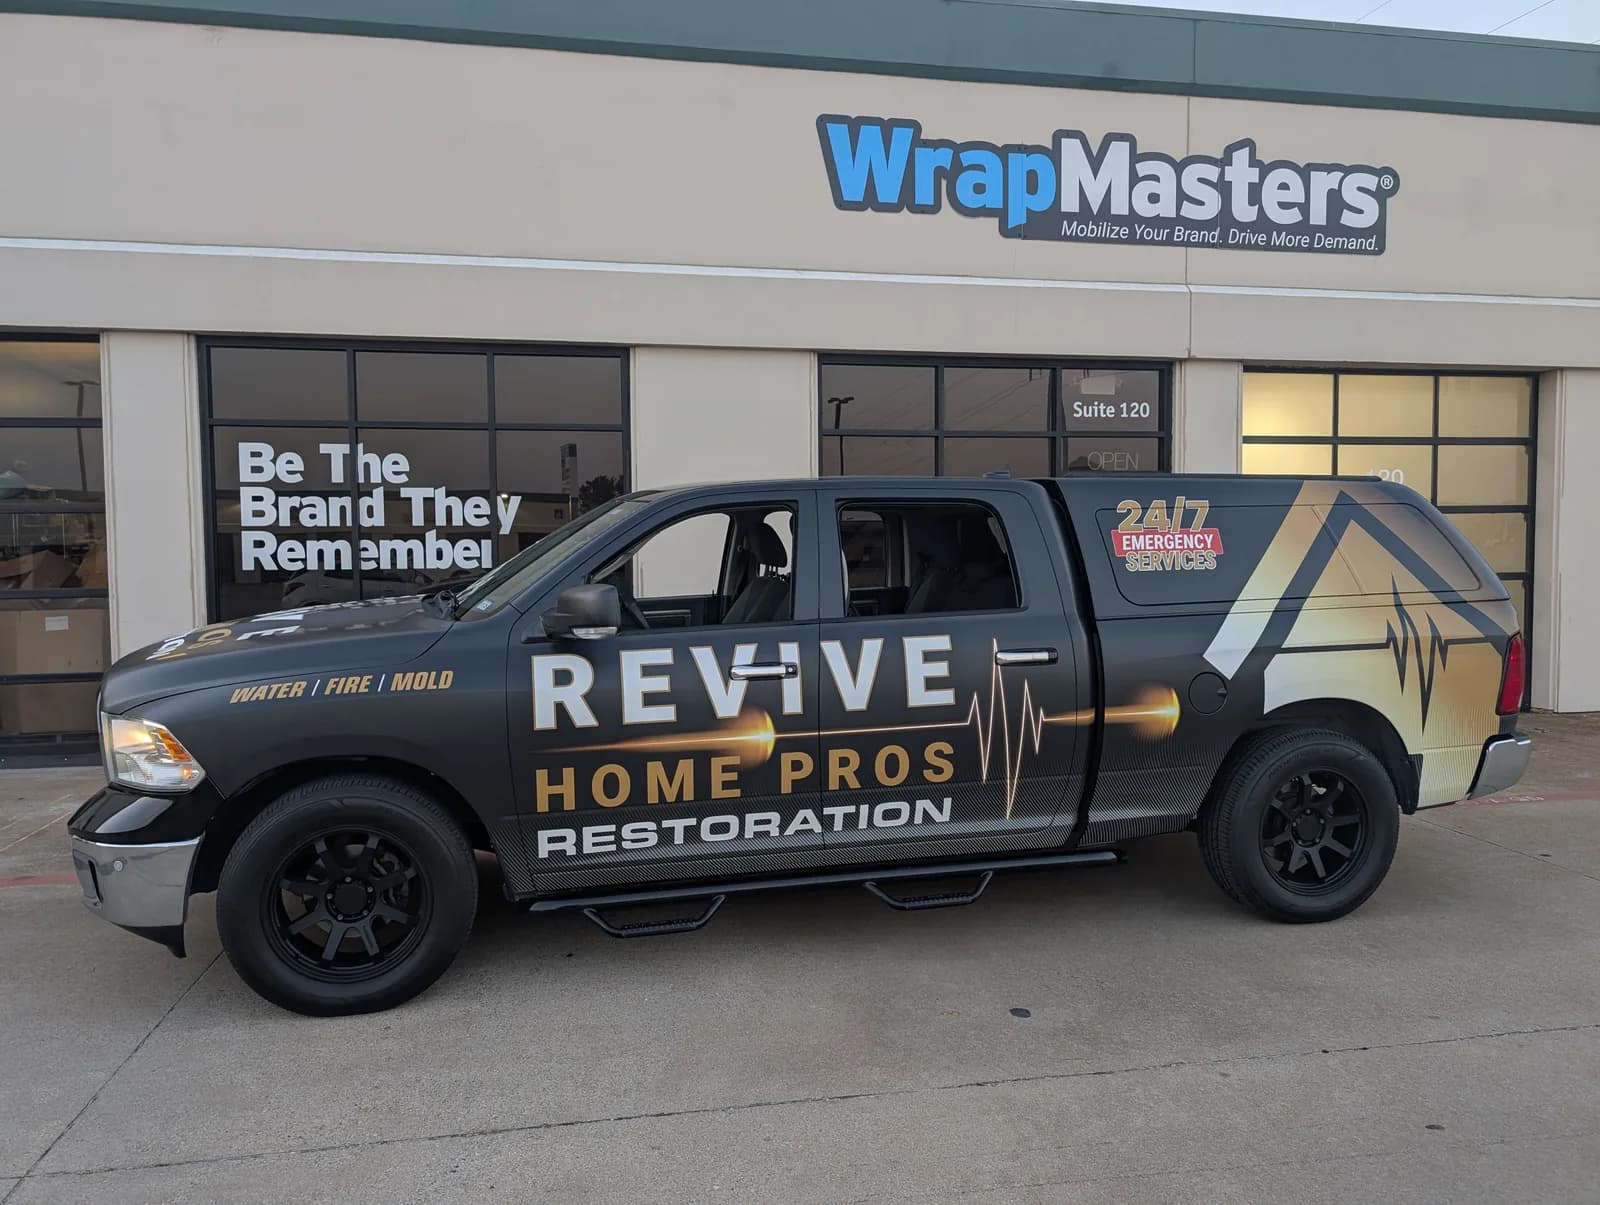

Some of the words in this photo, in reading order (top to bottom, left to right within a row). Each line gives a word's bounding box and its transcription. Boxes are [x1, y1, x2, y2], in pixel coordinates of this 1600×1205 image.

[1061, 220, 1129, 240] Mobilize
[1134, 224, 1169, 241] Your
[1174, 226, 1223, 243] Brand.
[1228, 229, 1266, 246] Drive
[1271, 232, 1310, 247] More
[1314, 233, 1379, 251] Demand.
[1073, 401, 1115, 417] Suite
[1120, 402, 1150, 417] 120
[238, 442, 304, 482] Be
[319, 443, 409, 484] The
[1088, 451, 1139, 470] OPEN
[240, 487, 385, 527] Brand
[400, 486, 522, 534] They
[1116, 496, 1210, 534] 24/7
[1122, 534, 1213, 551] EMERGENCY
[1125, 550, 1217, 572] SERVICES
[229, 681, 307, 704] WATER
[324, 675, 373, 696] FIRE
[391, 670, 454, 692] MOLD
[531, 634, 956, 731] REVIVE
[535, 755, 741, 813] HOME
[780, 741, 955, 794] PROS
[537, 797, 953, 859] RESTORATION
